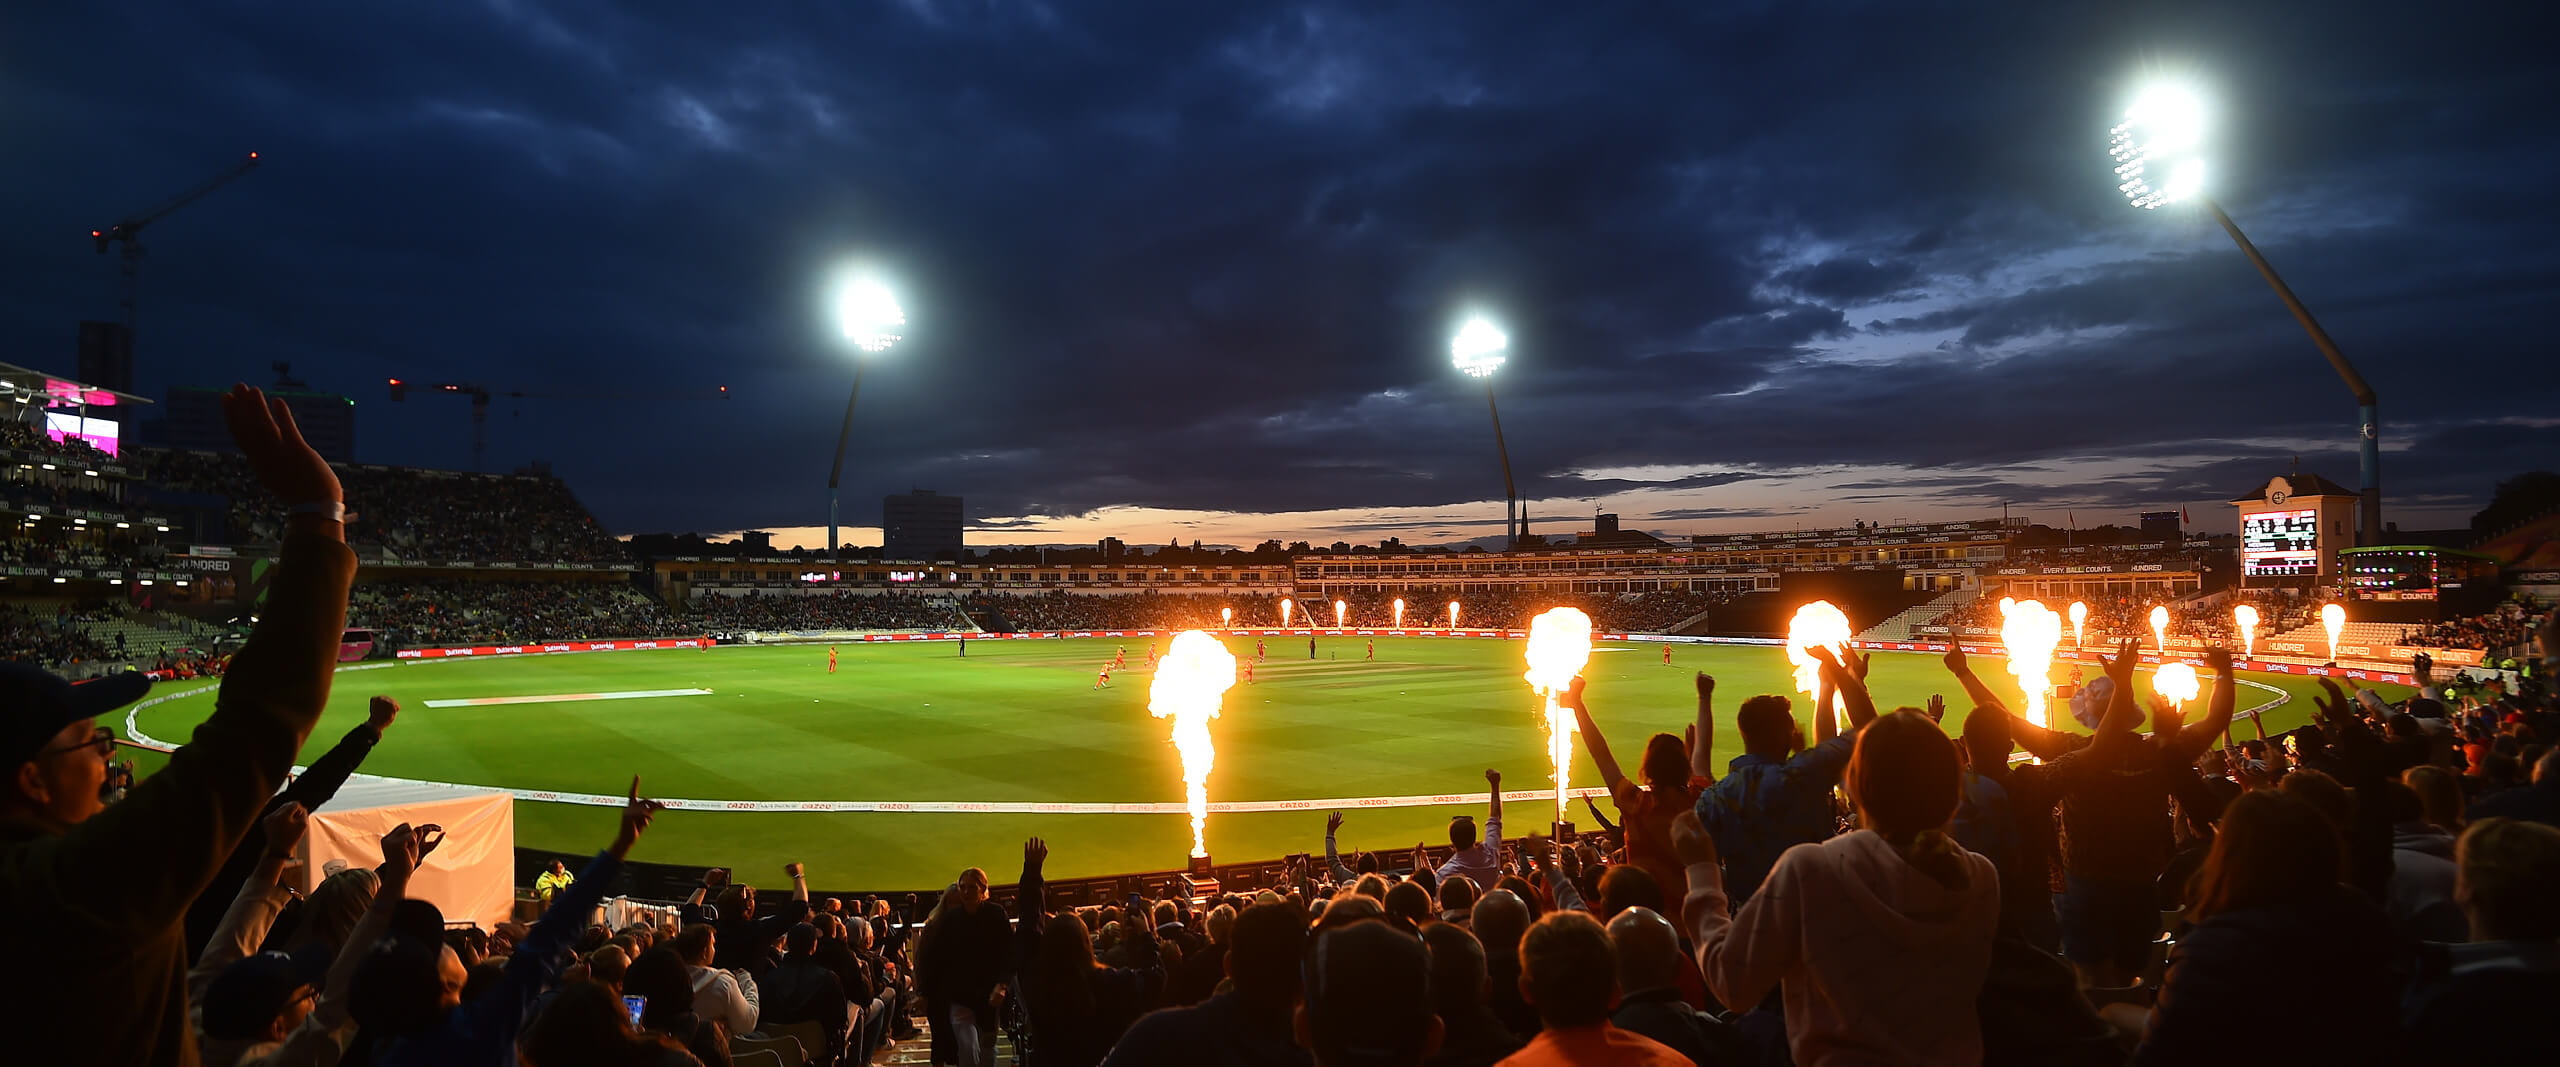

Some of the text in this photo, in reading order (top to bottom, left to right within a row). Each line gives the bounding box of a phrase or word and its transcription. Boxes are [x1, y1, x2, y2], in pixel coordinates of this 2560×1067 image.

[178, 559, 231, 571] HUNDRED
[2131, 564, 2163, 572] HUNDRED
[2269, 641, 2305, 652] HUNDRED
[1506, 792, 1534, 800] CAZOO
[1280, 801, 1311, 809] CAZOO
